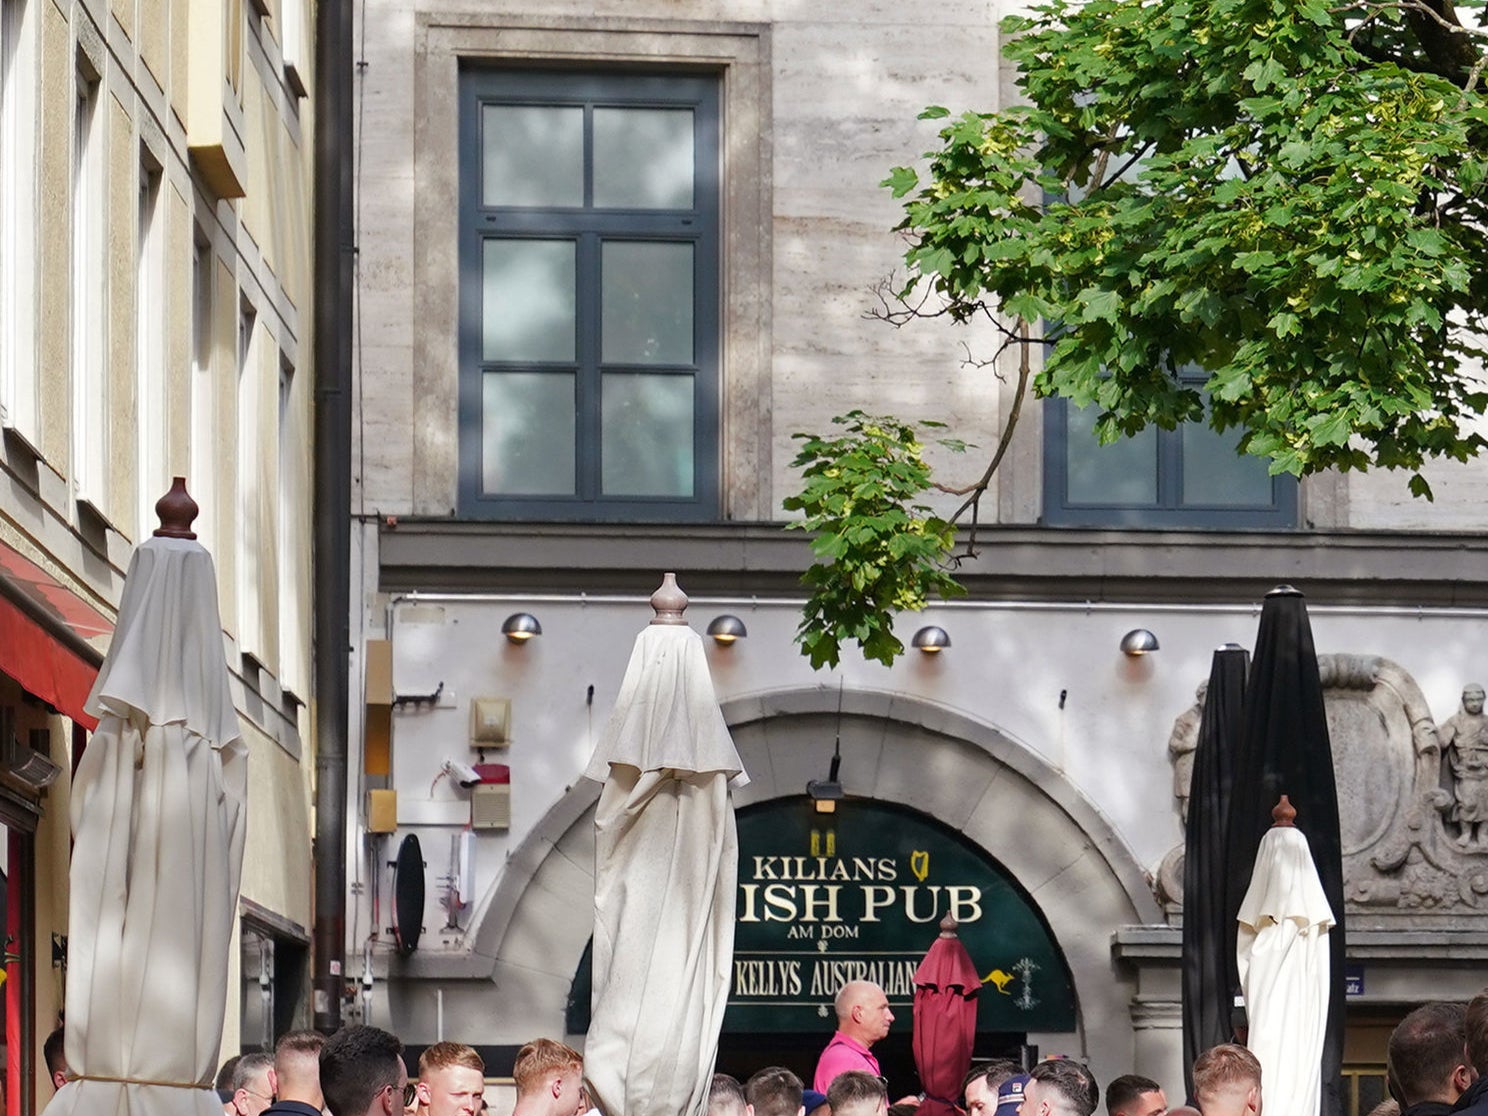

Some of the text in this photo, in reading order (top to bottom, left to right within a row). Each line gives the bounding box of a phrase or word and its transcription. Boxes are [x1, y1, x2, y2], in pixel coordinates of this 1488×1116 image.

[753, 856, 897, 881] KILIANS
[738, 884, 983, 923] ISH PUB
[787, 925, 859, 939] AM DOM
[735, 961, 801, 996] KELLYS
